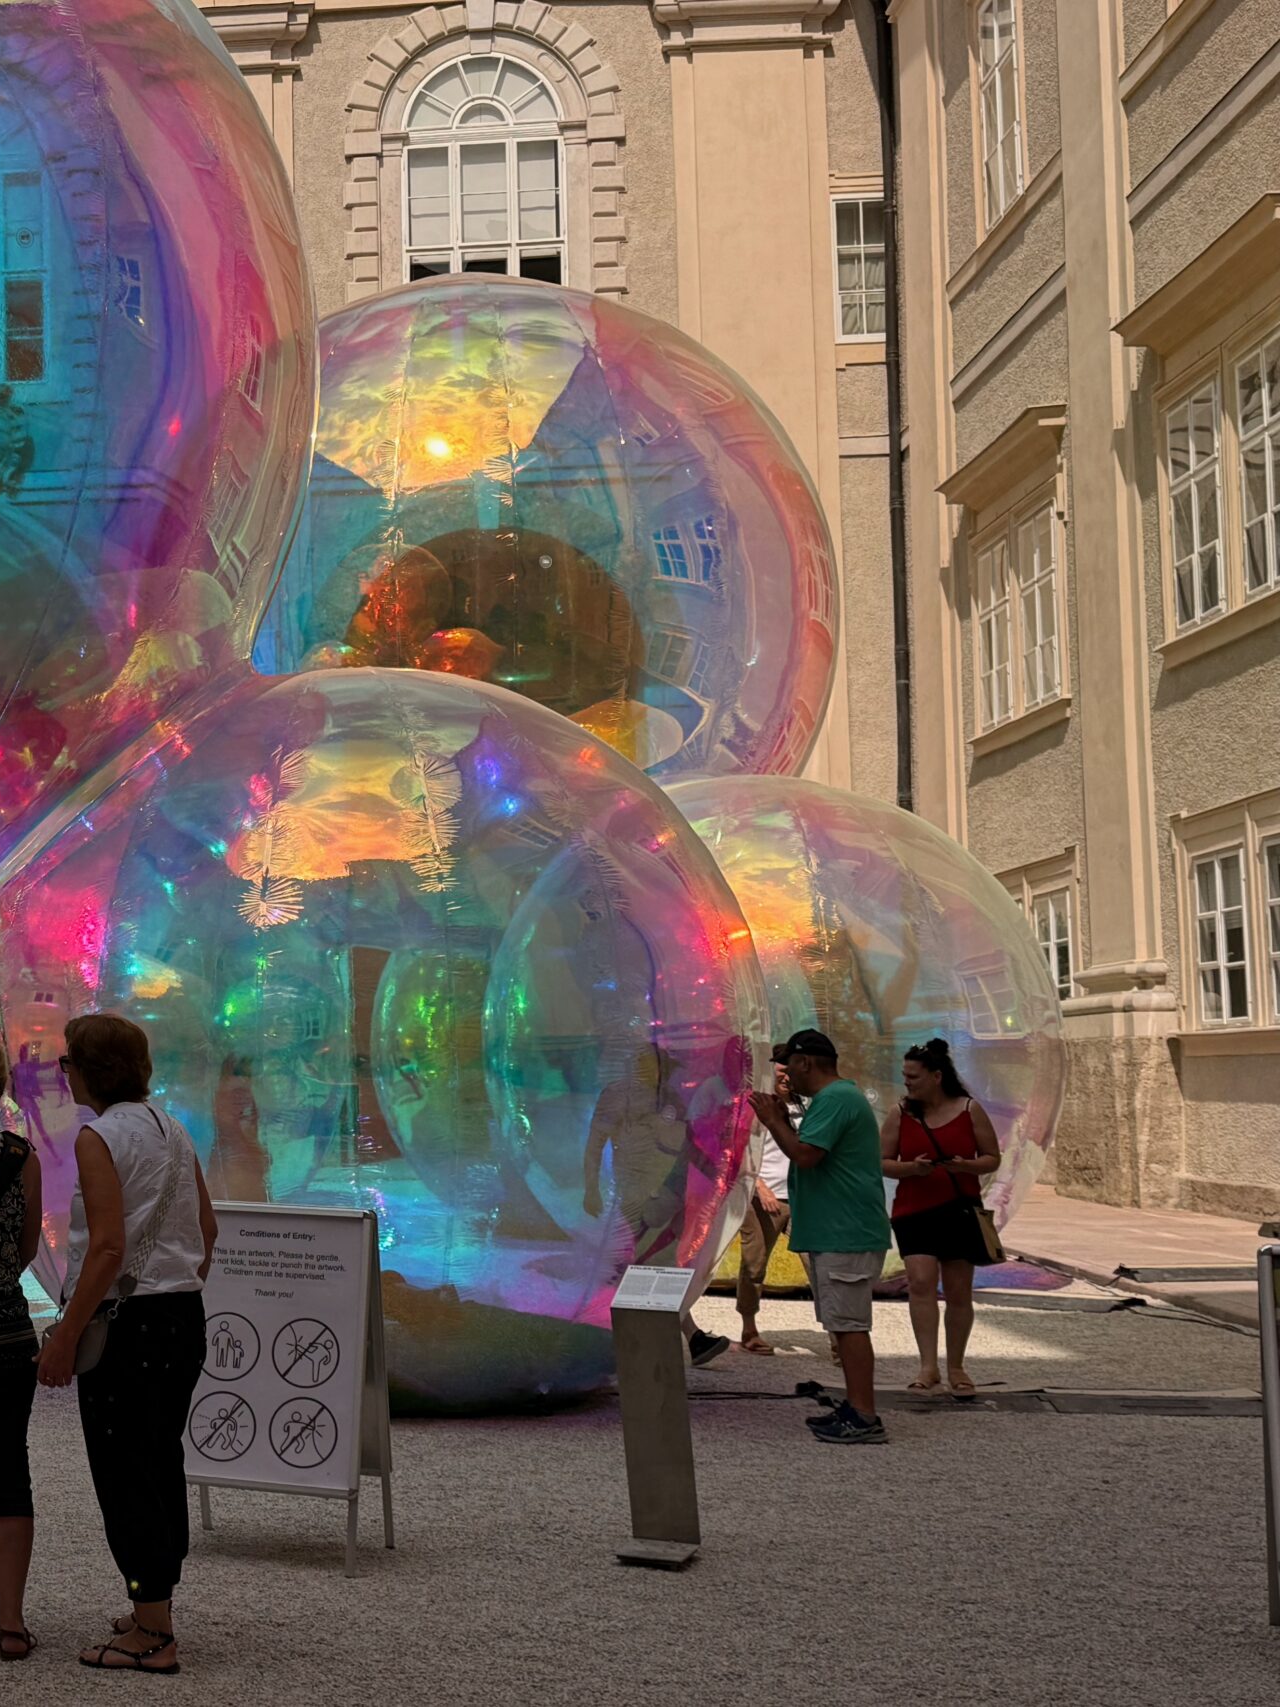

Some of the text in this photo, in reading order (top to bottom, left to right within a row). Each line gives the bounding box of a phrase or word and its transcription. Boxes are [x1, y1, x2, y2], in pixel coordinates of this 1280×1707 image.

[239, 1229, 316, 1242] Conditions of Entry:
[229, 1248, 236, 1256] is
[248, 1249, 277, 1258] artwork.
[278, 1250, 303, 1259] Please
[304, 1252, 315, 1260] be
[217, 1257, 229, 1265] not
[248, 1259, 270, 1267] tackle
[280, 1261, 303, 1269] punch
[304, 1262, 316, 1270] the
[317, 1263, 346, 1272] artwork.
[223, 1267, 254, 1276] Children
[274, 1269, 284, 1278] be
[285, 1271, 326, 1280] supervised.
[254, 1288, 294, 1299] Thank you!
